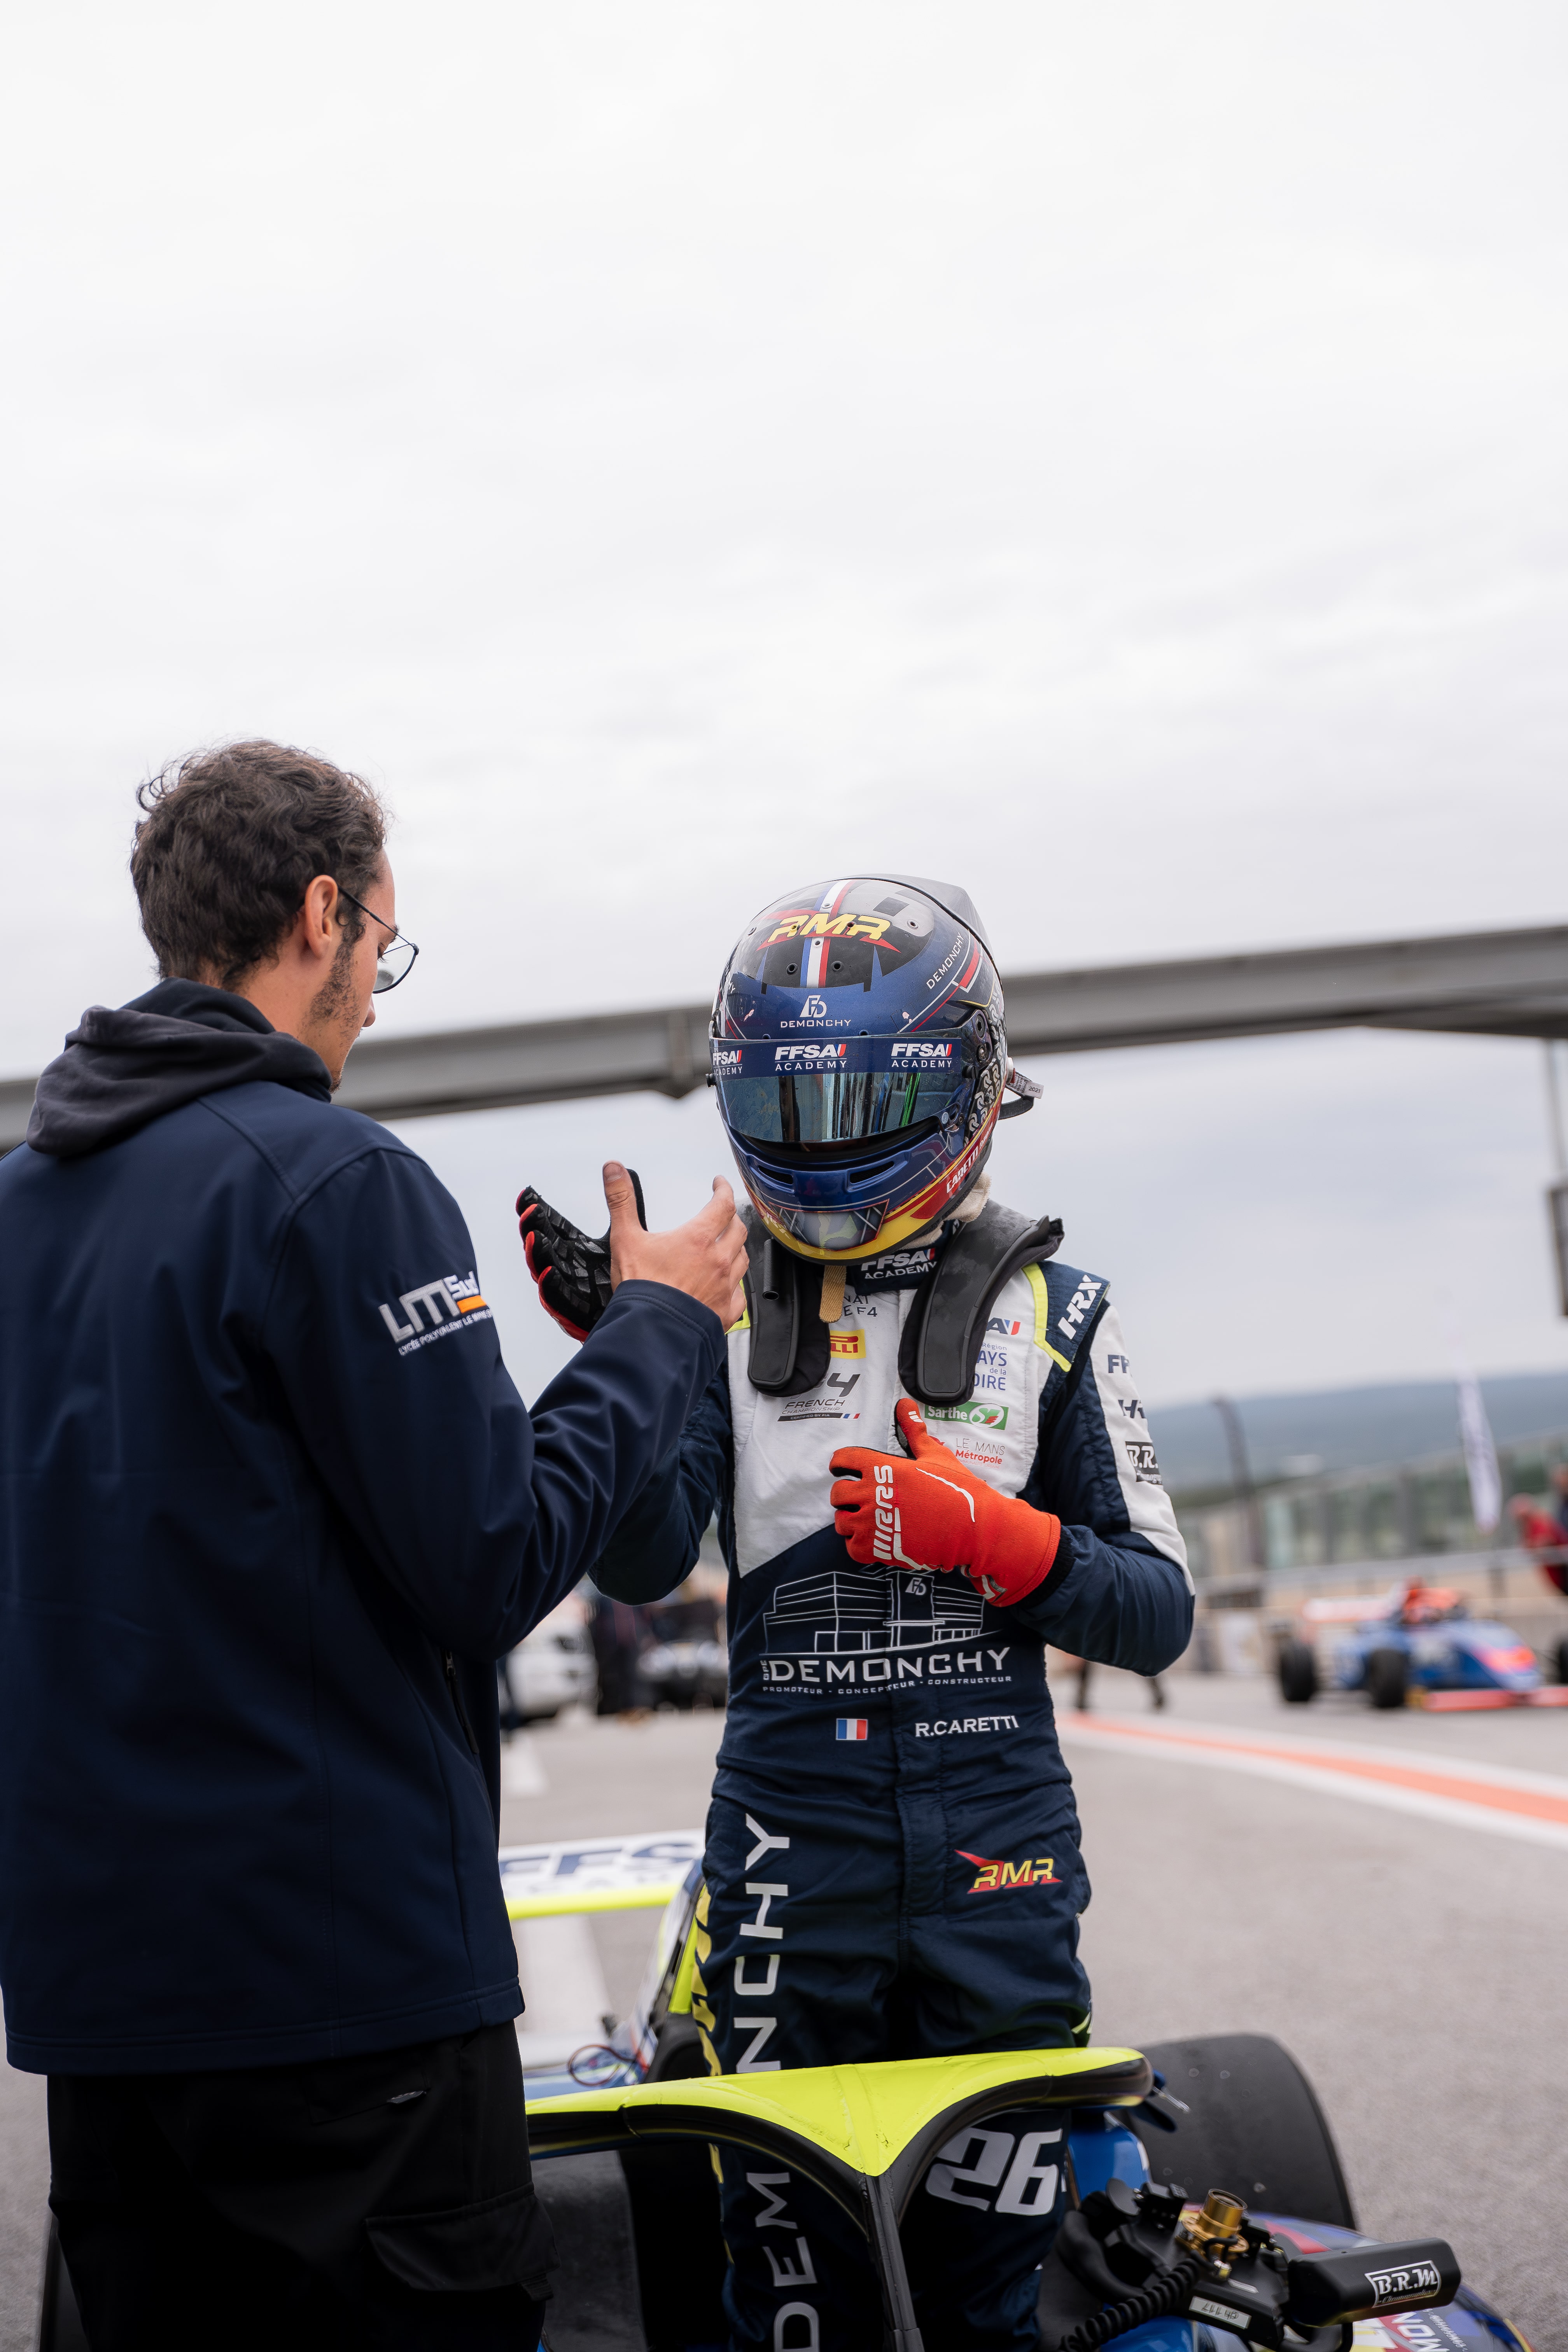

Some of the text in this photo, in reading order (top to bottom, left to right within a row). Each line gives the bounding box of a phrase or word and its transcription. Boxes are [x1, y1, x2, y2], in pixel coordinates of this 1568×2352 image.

[768, 913, 891, 942] RMR
[926, 932, 964, 990] DEMONCHY
[780, 1019, 852, 1028] DEMONCHY
[713, 1050, 737, 1066] FFSA
[775, 1044, 839, 1060] FFSA
[891, 1043, 947, 1057] FFSA
[714, 1066, 742, 1076] ACADEMY
[775, 1060, 847, 1071] ACADEMY
[891, 1060, 952, 1068] ACADEMY
[982, 1342, 1007, 1351] Région
[976, 1350, 1007, 1367] AYS
[974, 1373, 1006, 1391] OIRE
[784, 1399, 845, 1409] FRENCH
[928, 1405, 968, 1420] Sarthe
[956, 1438, 1006, 1456] LE MANS
[955, 1449, 1003, 1464] Métropole
[768, 1647, 1011, 1683] DEMONCHY
[763, 1676, 1012, 1694] PROMOTEUR CONCEPTEUR CONSTRUCTEUR
[915, 1715, 1019, 1738] R.CARETTI
[973, 1858, 1054, 1889] RMR
[926, 2127, 1062, 2216] 26
